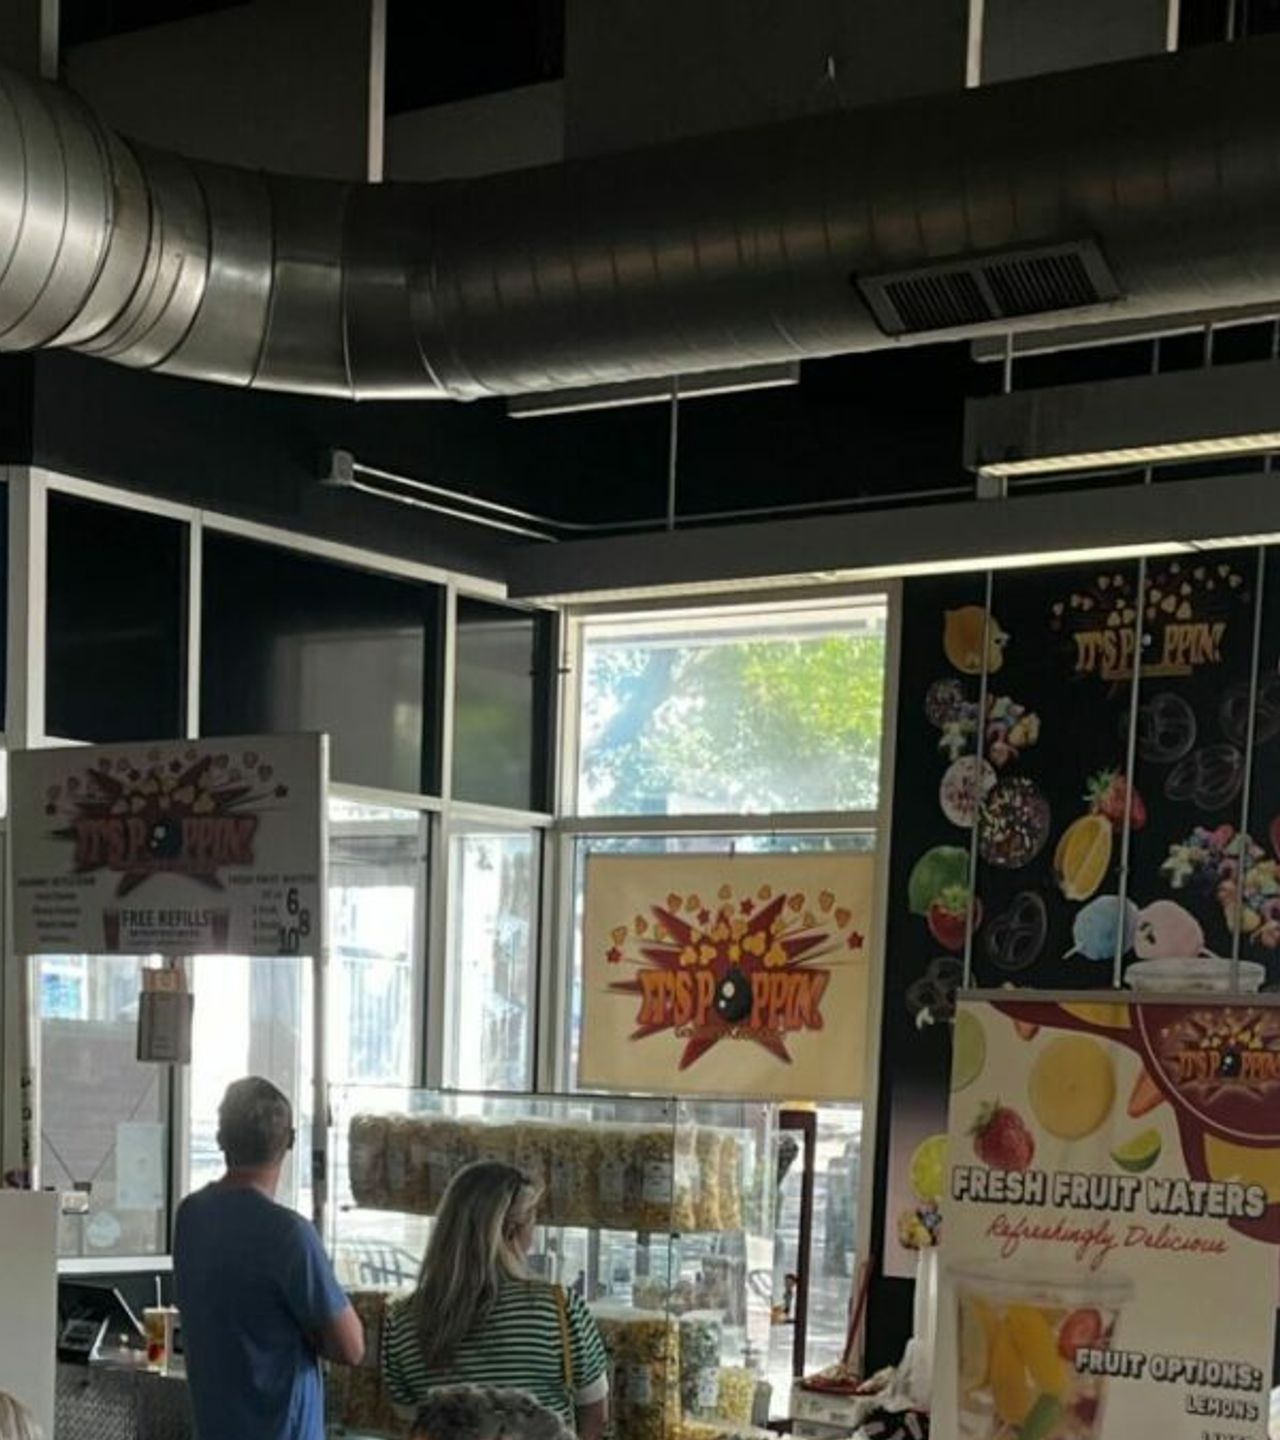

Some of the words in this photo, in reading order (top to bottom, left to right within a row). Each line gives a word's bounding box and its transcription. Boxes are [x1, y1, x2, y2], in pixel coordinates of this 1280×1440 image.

[121, 908, 154, 928] FREE
[158, 909, 209, 929] REFILLS
[287, 887, 299, 916] 6
[298, 908, 311, 936] 8
[637, 969, 694, 1026] IT'S
[952, 1165, 1045, 1203] FRESH
[1053, 1171, 1141, 1212] FRUIT
[1147, 1178, 1265, 1219] WATERS
[985, 1212, 1119, 1271] Refreshingly
[1124, 1221, 1231, 1256] Delicious
[1075, 1348, 1146, 1379] FRUIT
[1149, 1355, 1264, 1393] OPTIONS:
[1185, 1396, 1260, 1422] LEMONS
